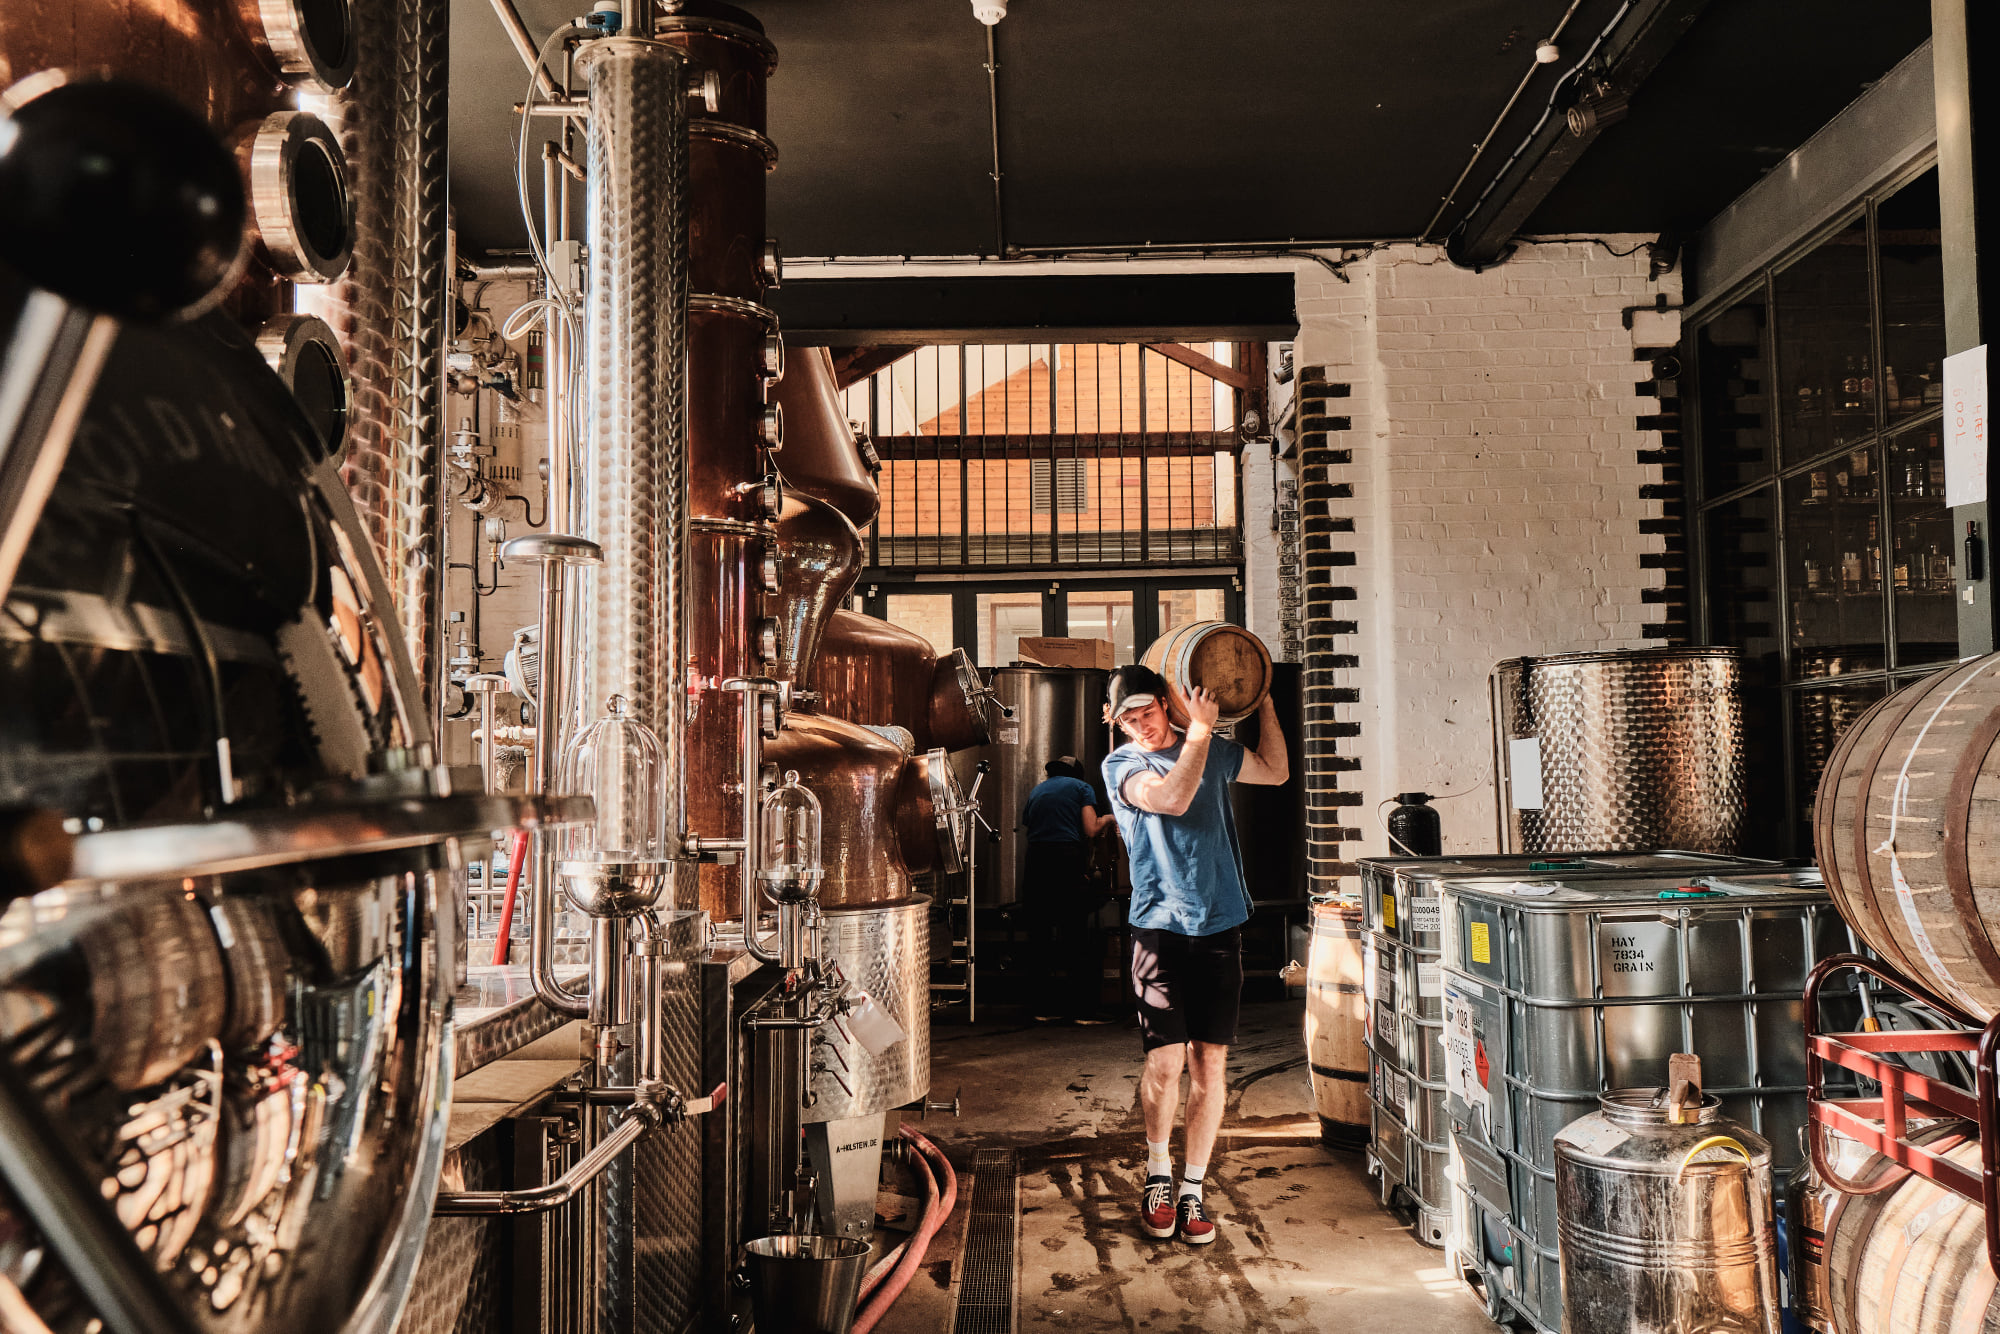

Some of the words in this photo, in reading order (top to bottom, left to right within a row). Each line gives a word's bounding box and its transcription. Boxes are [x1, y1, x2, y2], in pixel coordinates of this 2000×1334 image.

[1611, 936, 1635, 948] HAY
[1612, 950, 1644, 960] 7834
[1613, 961, 1654, 972] GRAIN
[1456, 1007, 1468, 1029] 108
[836, 1138, 877, 1153] A-HOLSTEIN.DE
